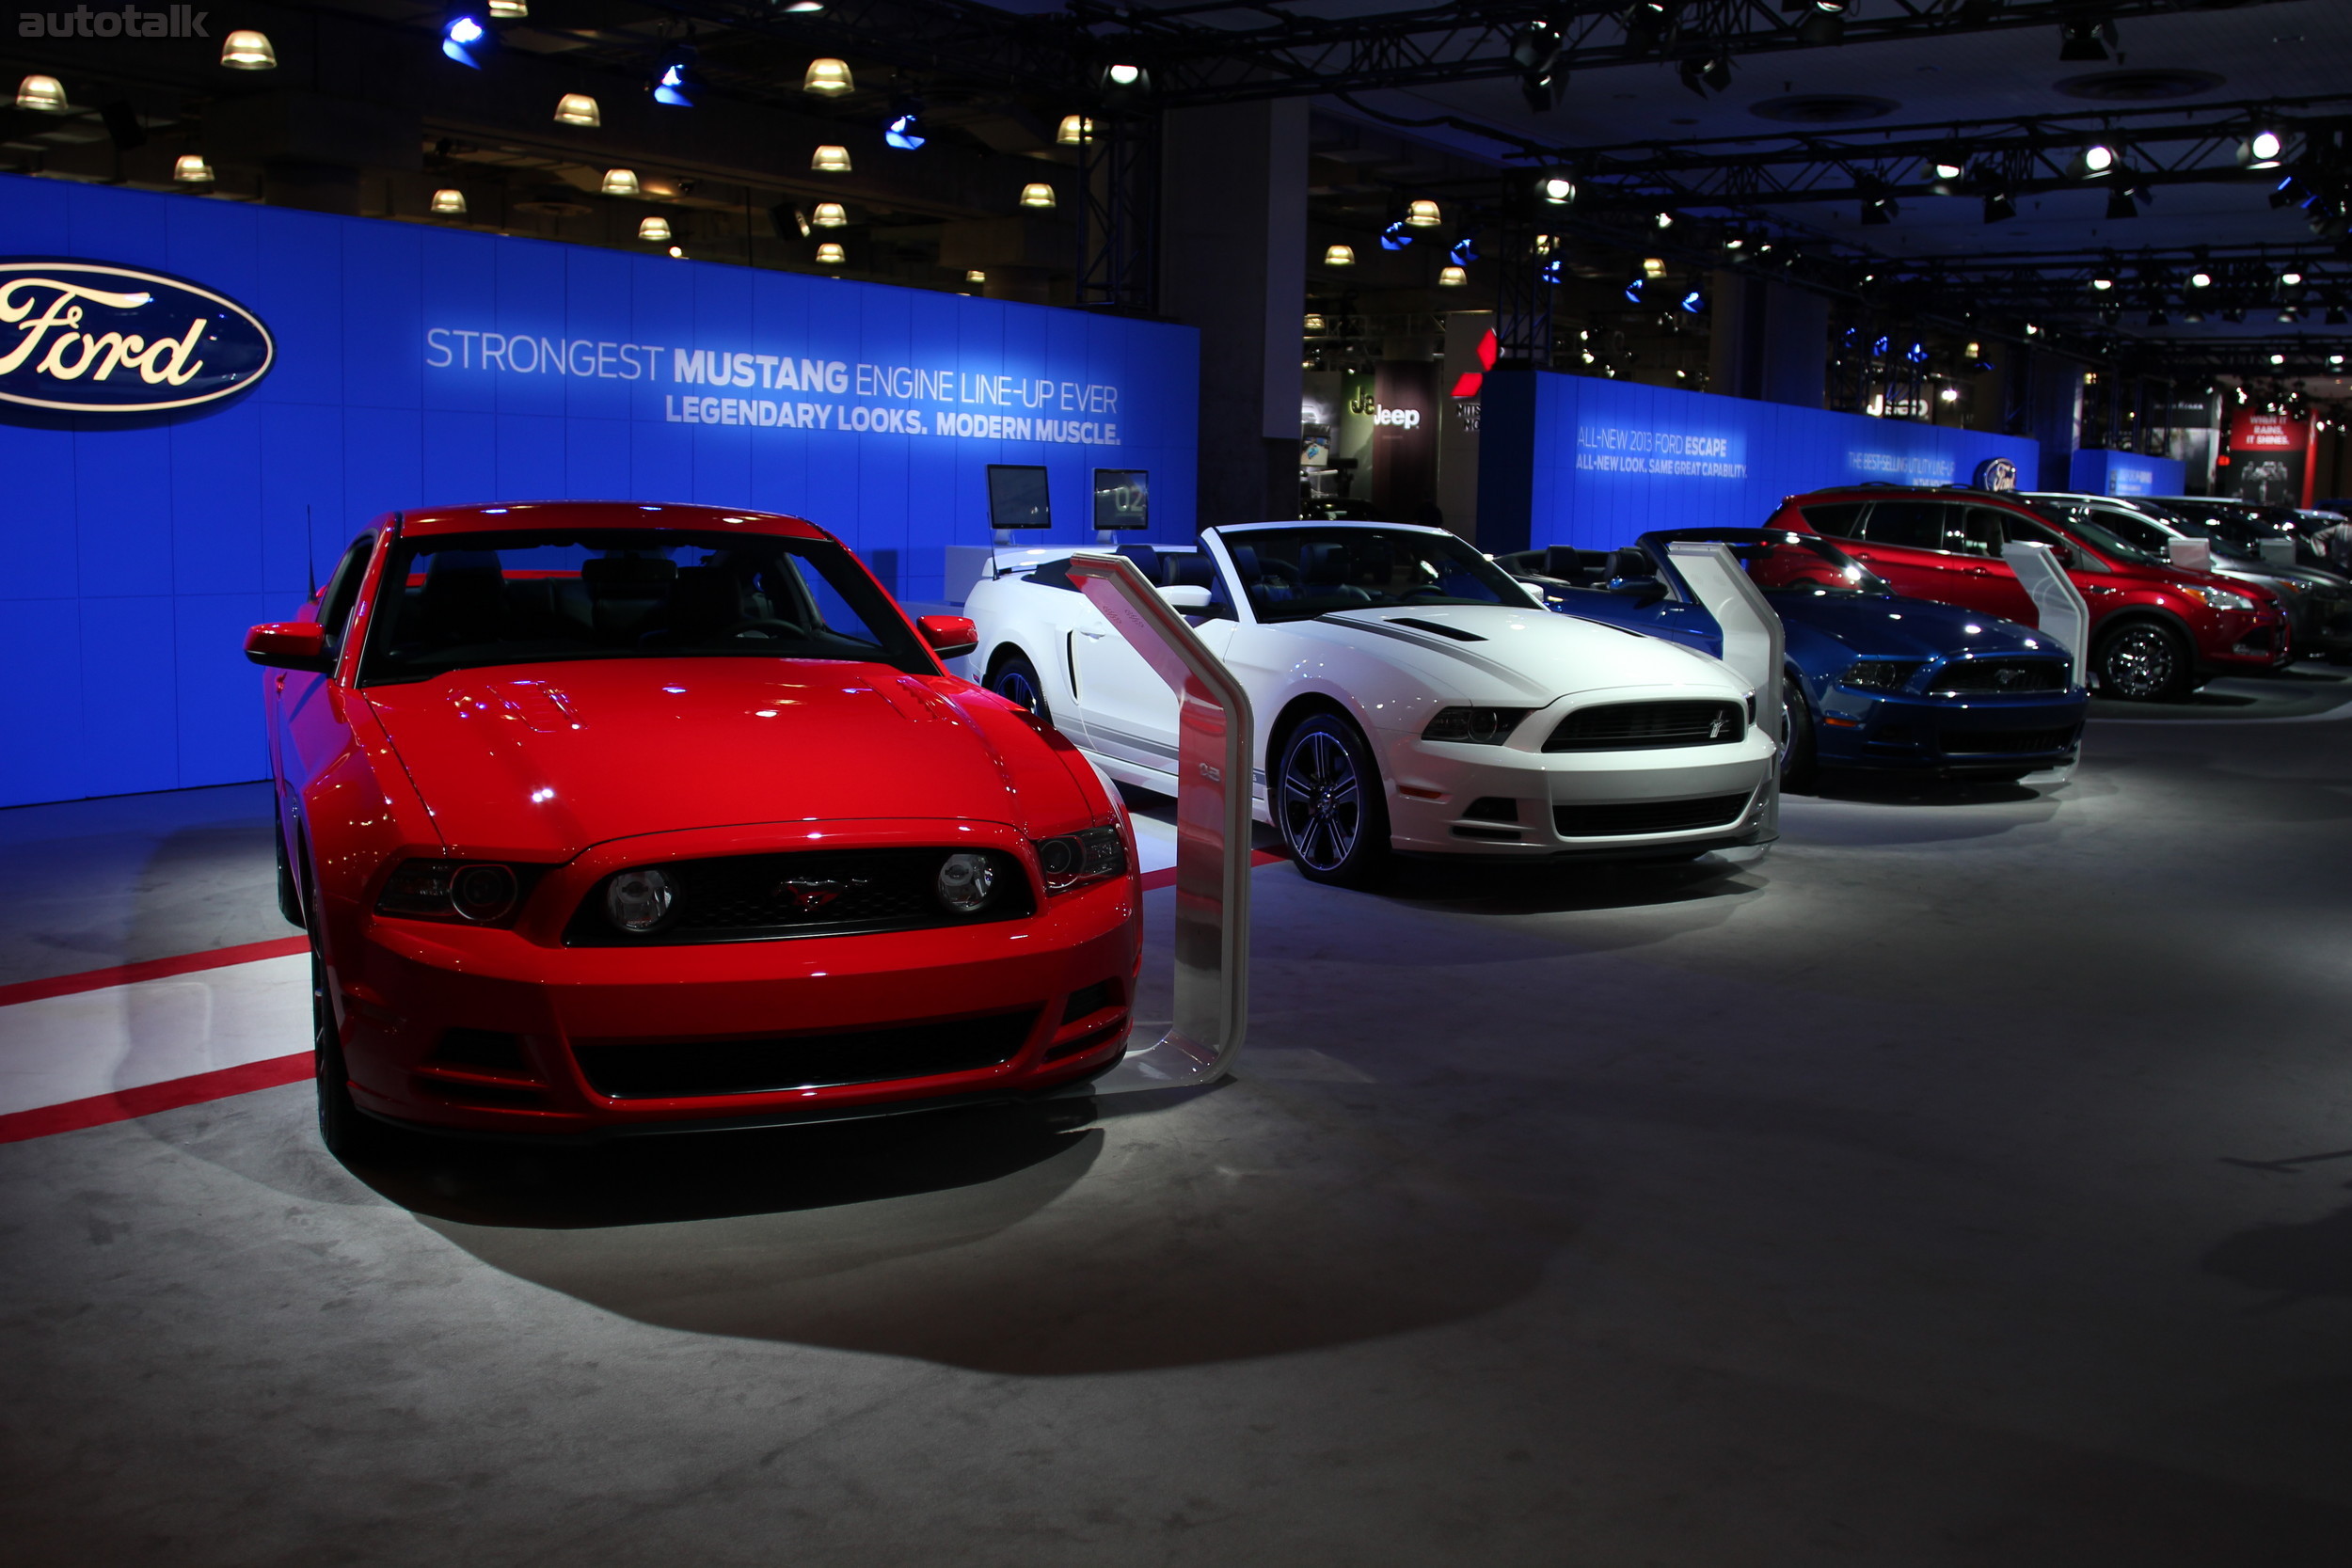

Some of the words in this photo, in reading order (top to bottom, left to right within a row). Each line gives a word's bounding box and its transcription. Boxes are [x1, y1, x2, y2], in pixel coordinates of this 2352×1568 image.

[0, 277, 204, 386] Ford
[426, 327, 664, 381] STRONGEST
[674, 348, 849, 394] MUSTANG
[856, 363, 954, 403] ENGINE
[961, 373, 1055, 409] LINE-UP
[1060, 382, 1119, 415] EVER
[665, 394, 833, 430] LEGENDARY
[837, 405, 929, 436] LOOKS.
[936, 413, 1031, 441] MODERN
[1036, 419, 1121, 446] MUSCLE.
[1375, 404, 1420, 429] Jeep
[1577, 426, 1629, 451] ALL-NEW
[1629, 431, 1653, 452] 2013
[1655, 433, 1683, 454] FORD
[1685, 436, 1727, 457] ESCAPE
[2246, 435, 2255, 444] IT
[1576, 453, 1619, 472] ALL-NEW
[1620, 457, 1647, 473] LOOK.
[1648, 458, 1673, 475] SAME
[1675, 460, 1701, 476] GREAT
[1702, 462, 1748, 478] CAPABILITY.
